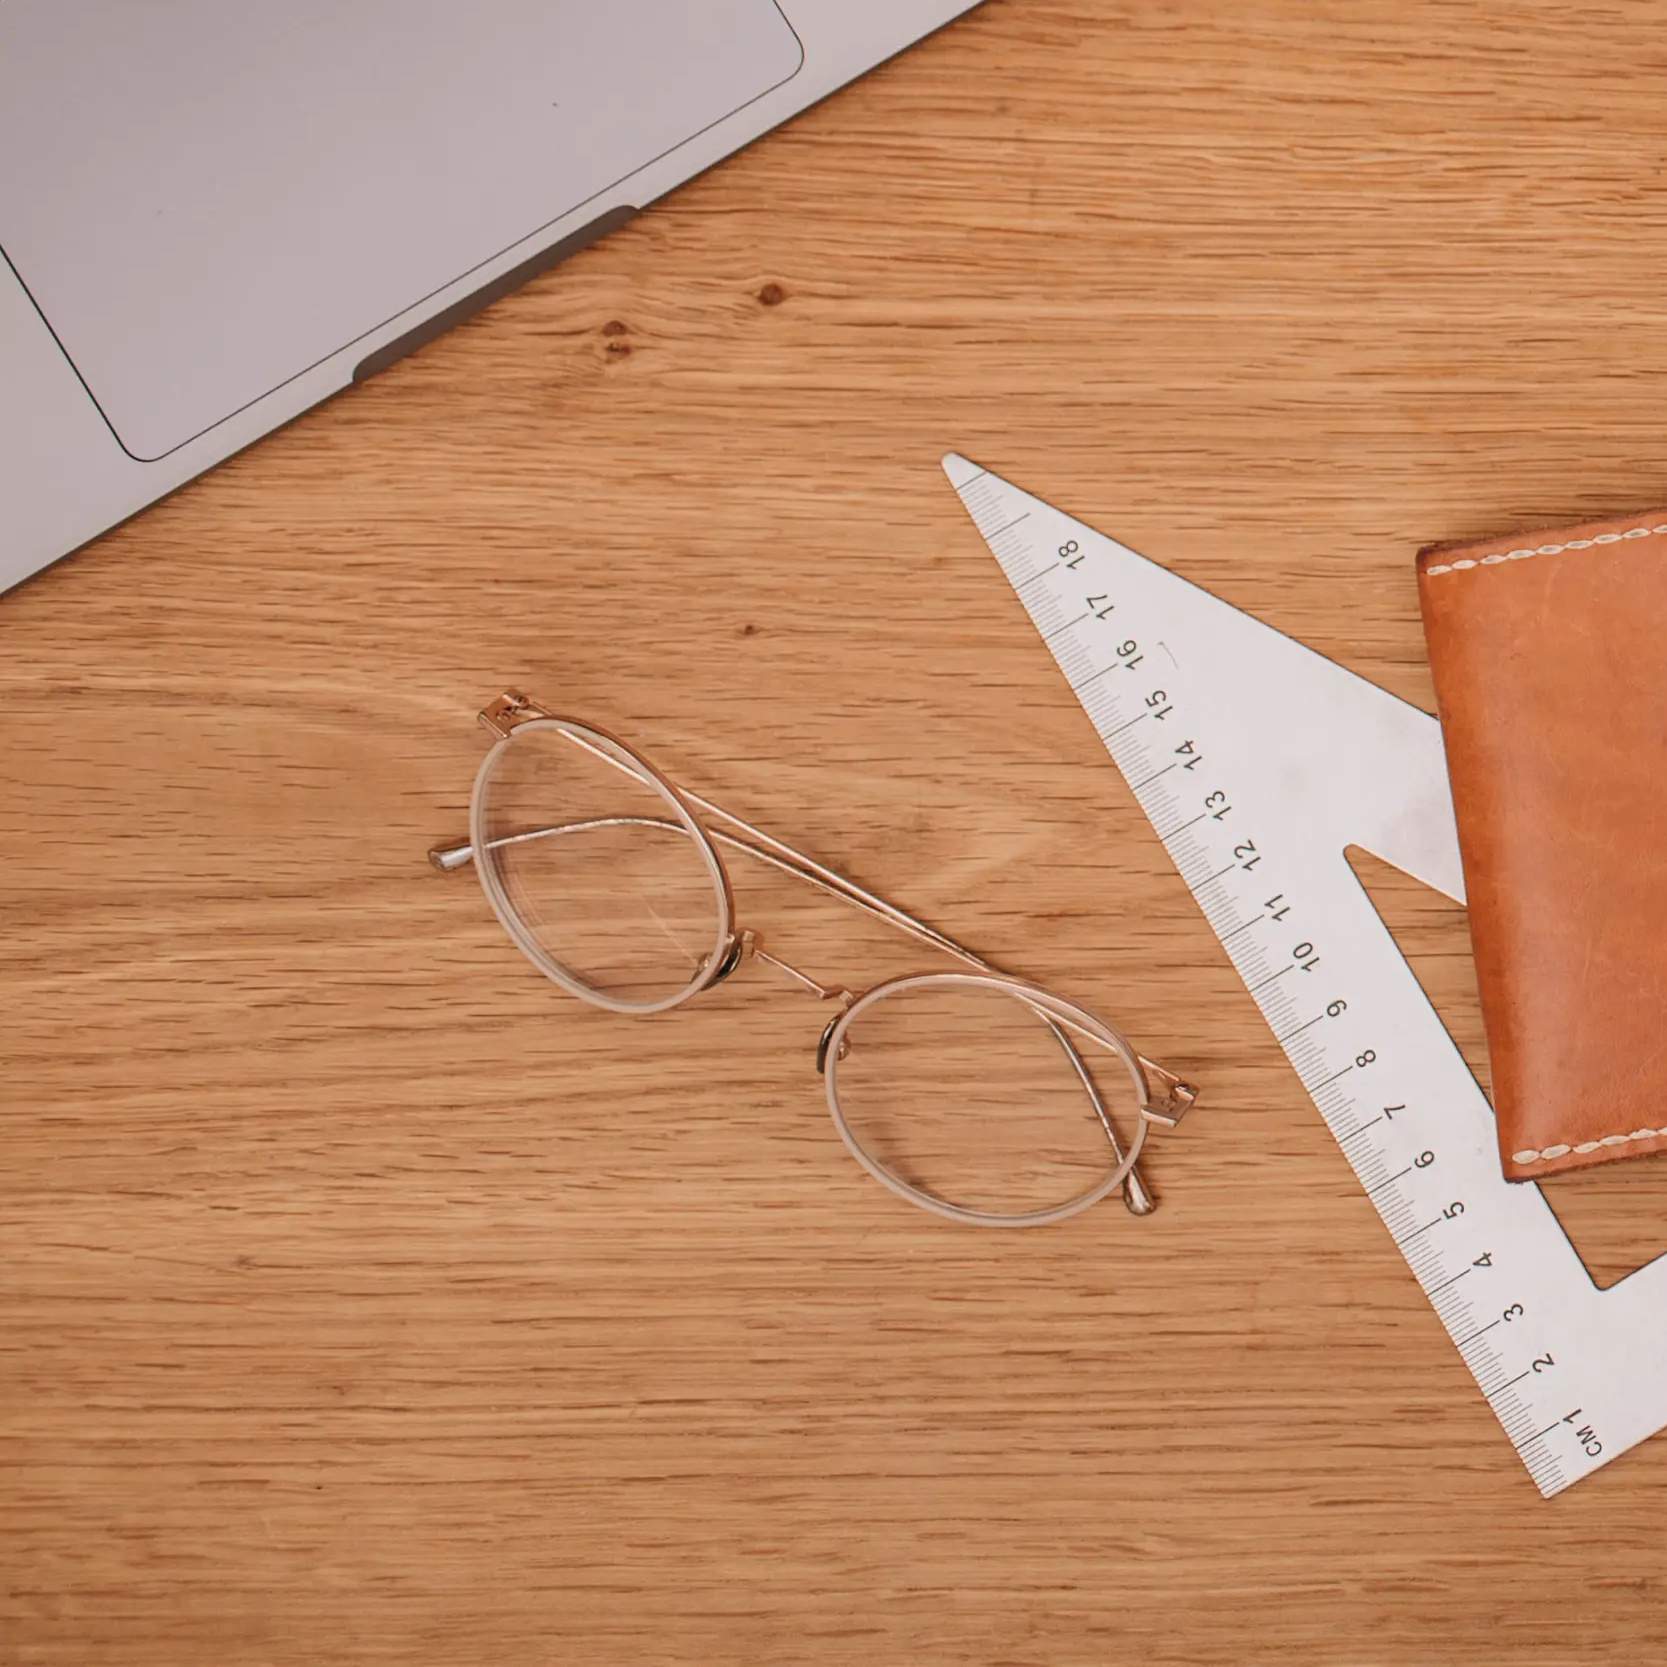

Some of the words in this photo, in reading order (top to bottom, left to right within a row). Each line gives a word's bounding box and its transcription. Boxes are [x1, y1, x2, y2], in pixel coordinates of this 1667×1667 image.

[1059, 541, 1084, 569] 18
[1088, 595, 1114, 619] 17
[1117, 640, 1143, 670] 16
[1146, 691, 1172, 720] 15
[1176, 741, 1202, 770] 14
[1205, 791, 1231, 820] 13
[1234, 840, 1260, 871] 12
[1264, 894, 1290, 921] 11
[1293, 943, 1319, 971] 10
[1327, 1000, 1346, 1017] 9
[1356, 1050, 1376, 1067] 8
[1384, 1105, 1405, 1119] 7
[1415, 1151, 1434, 1168] 6
[1443, 1202, 1464, 1219] 5
[1473, 1253, 1492, 1266] 4
[1504, 1304, 1523, 1321] 3
[1532, 1353, 1554, 1372] 2
[1563, 1409, 1581, 1423] 1
[1576, 1426, 1602, 1456] CM
